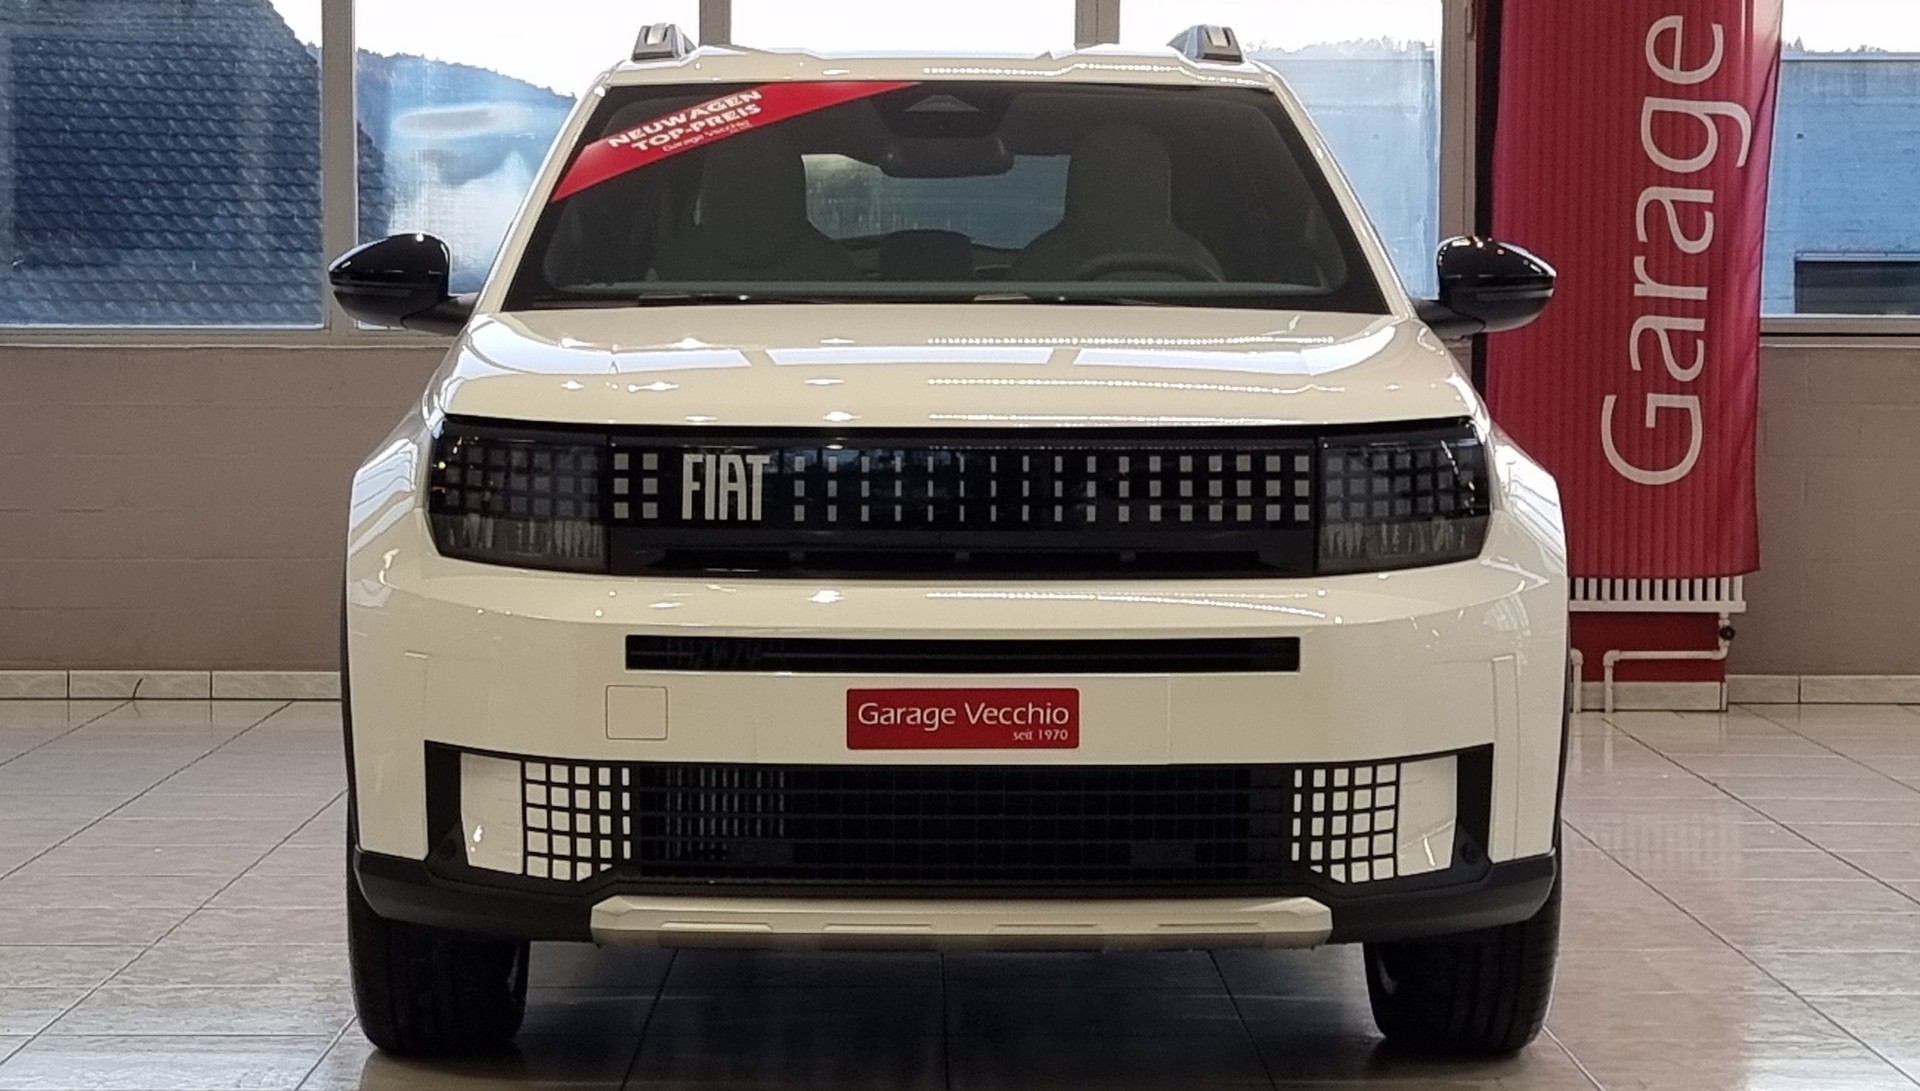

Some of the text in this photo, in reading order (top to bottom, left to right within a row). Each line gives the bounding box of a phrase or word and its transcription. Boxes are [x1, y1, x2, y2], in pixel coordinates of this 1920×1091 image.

[608, 90, 762, 147] NEUWAGEN
[631, 104, 762, 151] TOP-PREIS
[1600, 14, 1752, 485] Garage
[682, 454, 770, 520] FIAT
[858, 702, 1069, 731] Garage Vecchio
[1013, 729, 1069, 740] seit 1970
